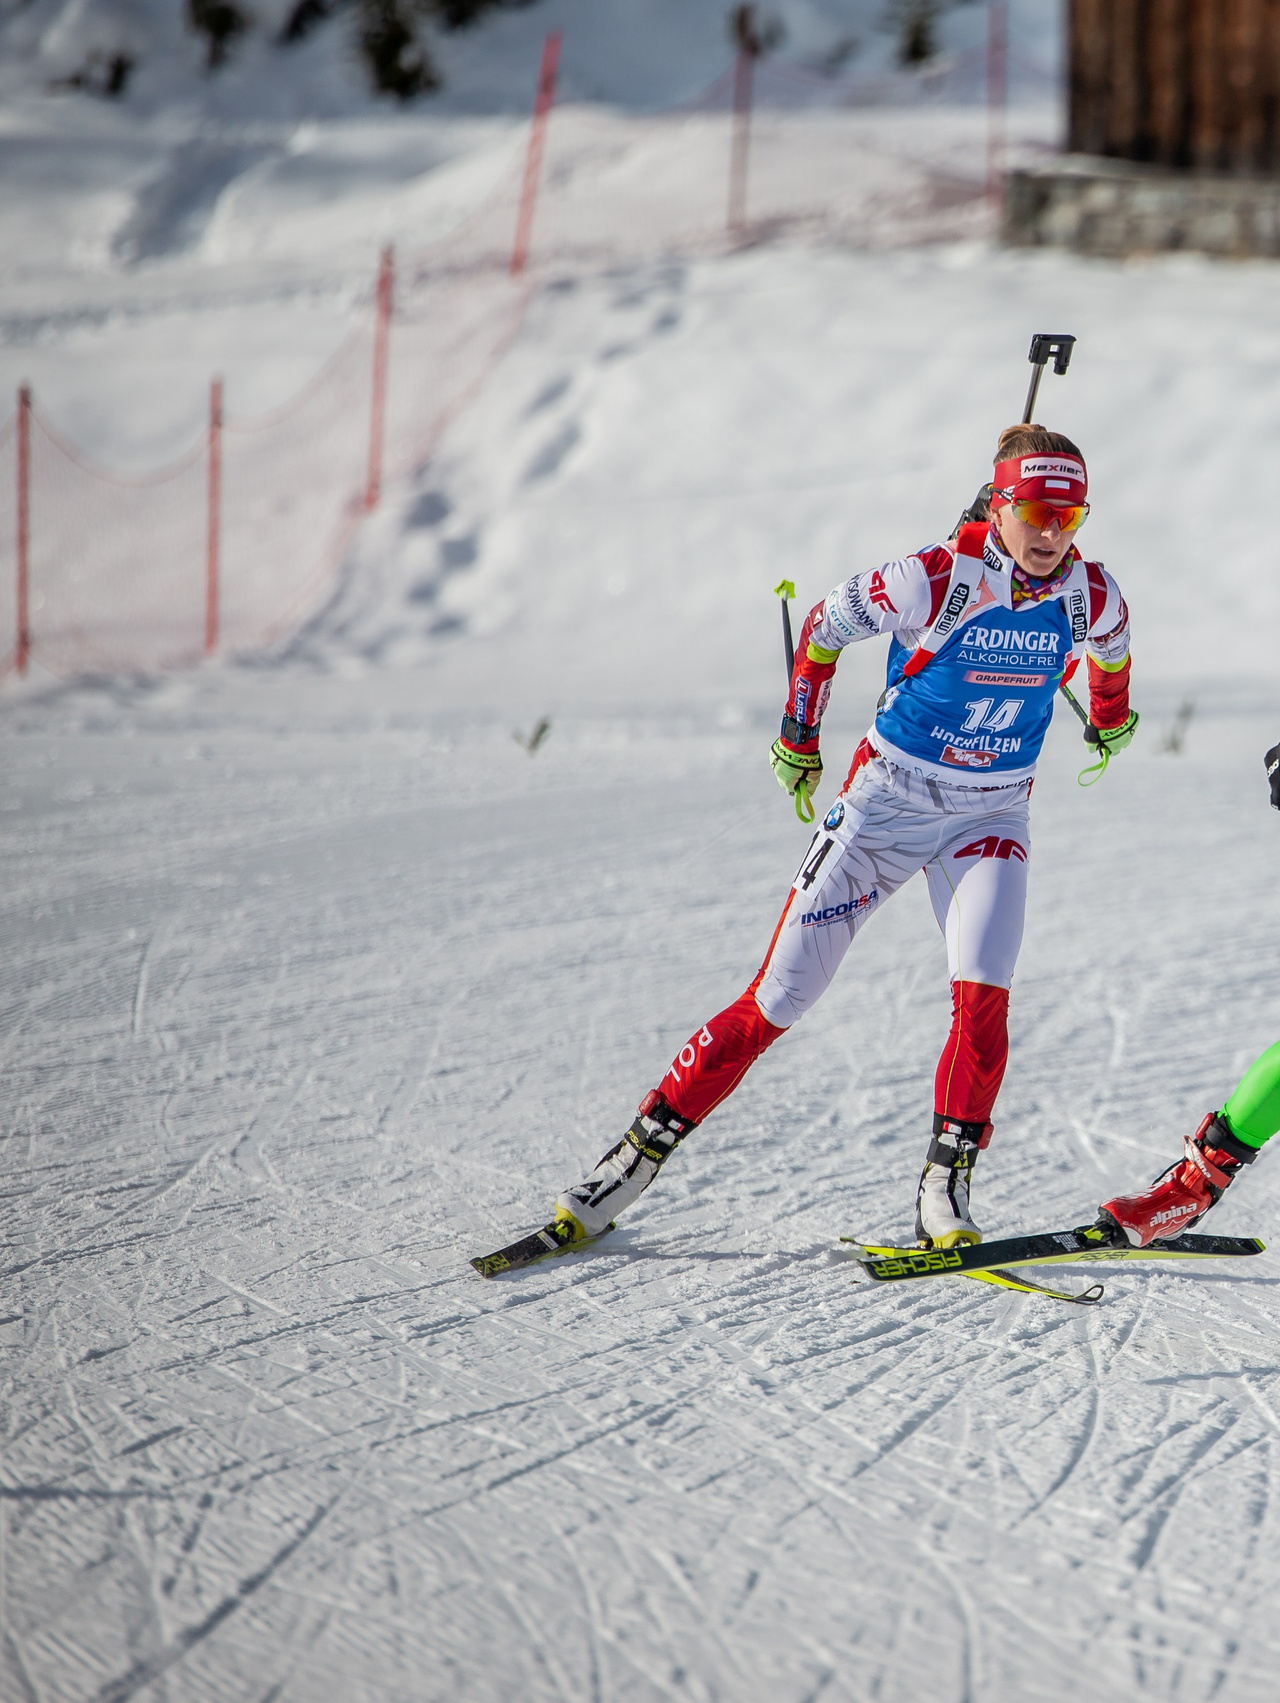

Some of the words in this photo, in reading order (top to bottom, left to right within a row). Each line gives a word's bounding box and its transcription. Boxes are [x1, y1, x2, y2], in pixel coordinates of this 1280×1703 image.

[961, 625, 1060, 653] ERDINGER
[957, 650, 1056, 666] ALKOHOLFREI
[975, 664, 1039, 684] GRAPEFRUIT
[960, 698, 1025, 734] 14
[801, 890, 878, 925] INCORSA
[665, 1025, 713, 1082] POL
[1149, 1202, 1198, 1228] alpina
[870, 1250, 963, 1278] FISCHER
